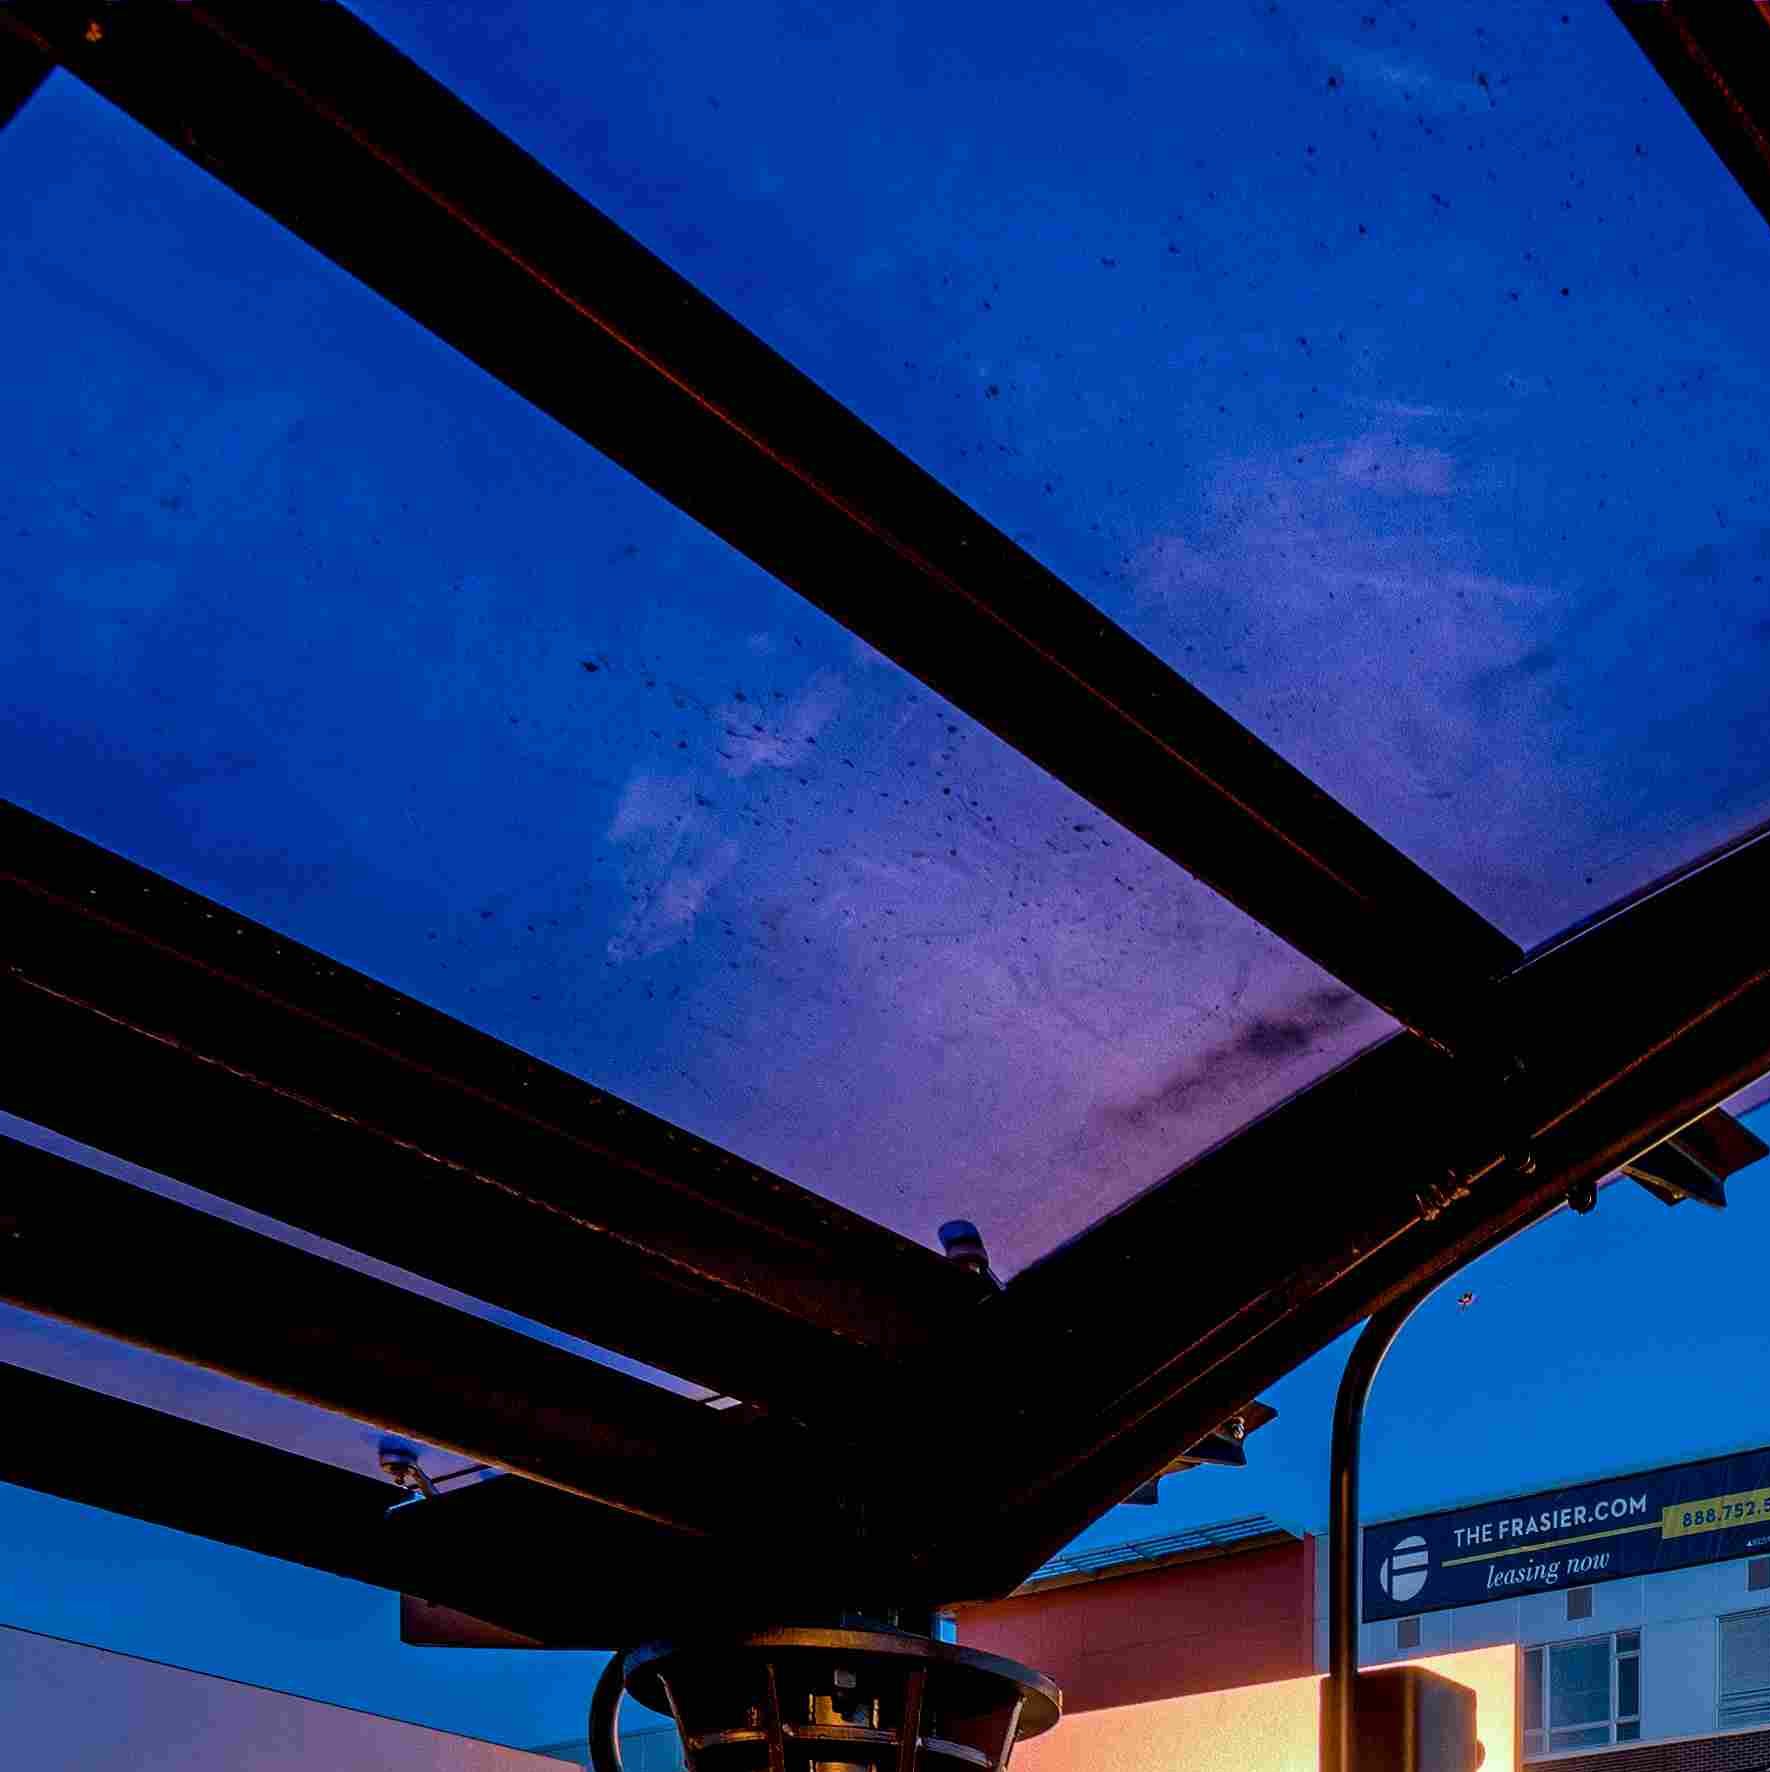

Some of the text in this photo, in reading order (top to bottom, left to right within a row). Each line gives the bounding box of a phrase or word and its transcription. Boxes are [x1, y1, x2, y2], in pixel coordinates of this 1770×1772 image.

[1453, 1493, 1647, 1548] THE FRASIER.COM
[1486, 1552, 1611, 1589] leasing now
